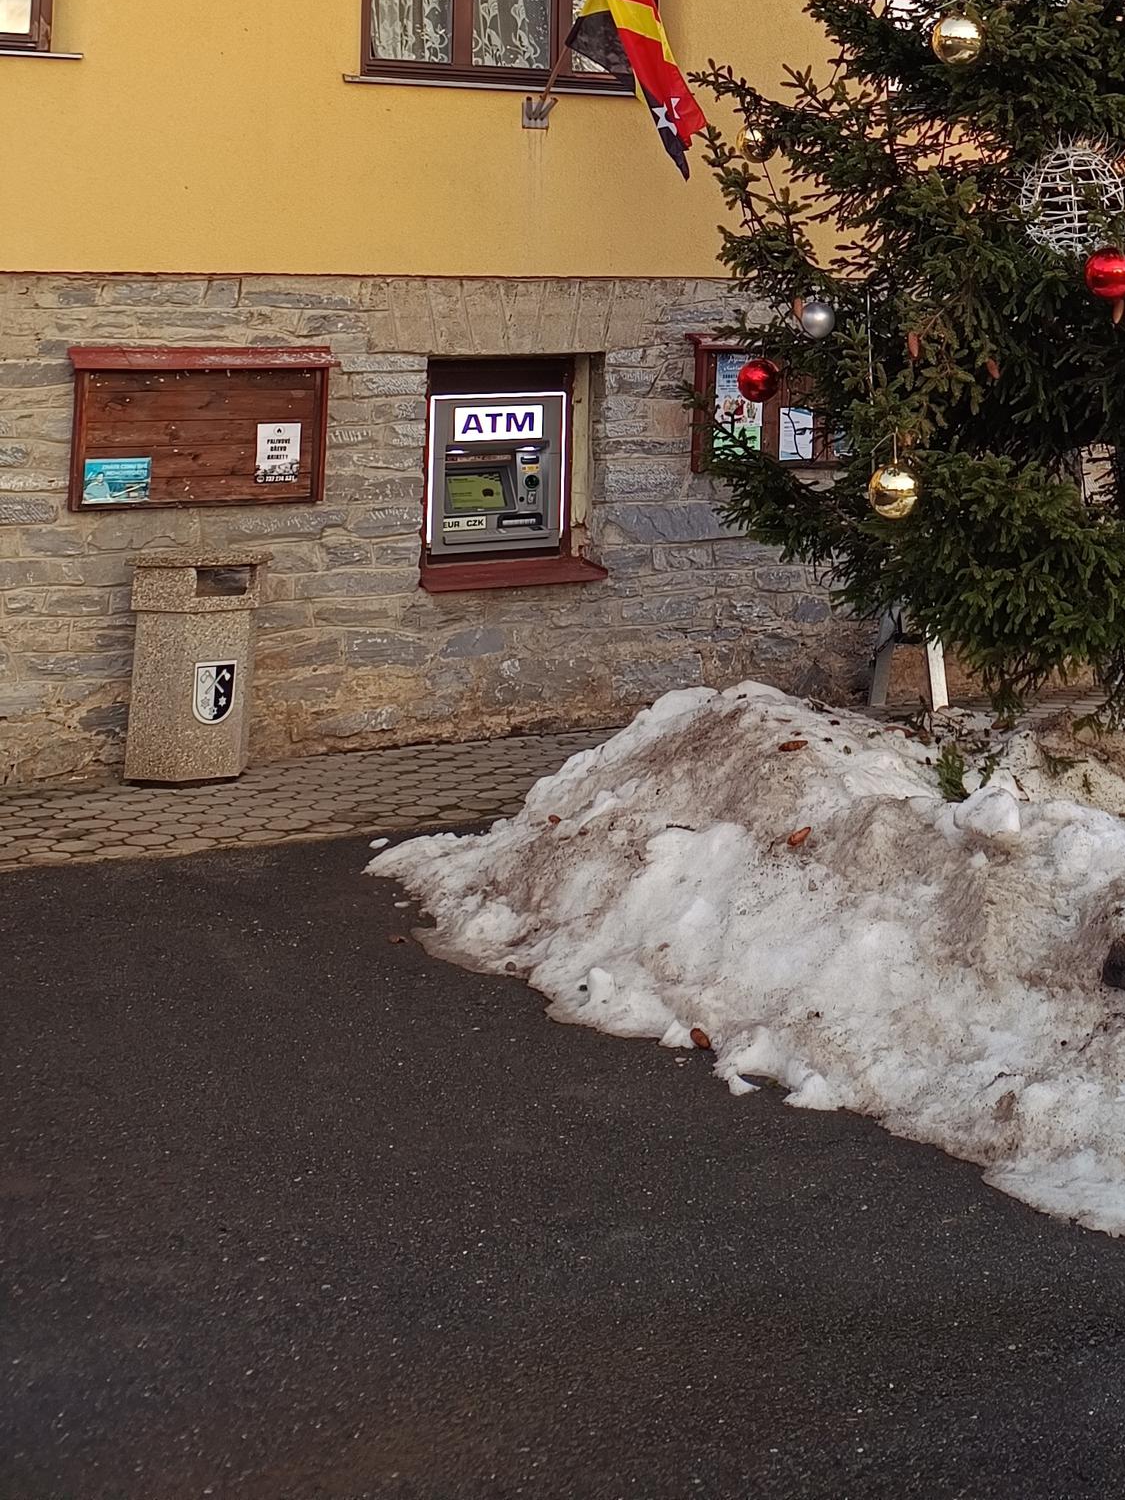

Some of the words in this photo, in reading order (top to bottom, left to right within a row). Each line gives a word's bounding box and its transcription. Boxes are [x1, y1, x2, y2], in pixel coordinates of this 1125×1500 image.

[462, 412, 535, 434] ATM
[443, 520, 460, 528] EUR
[466, 519, 484, 527] CZK
